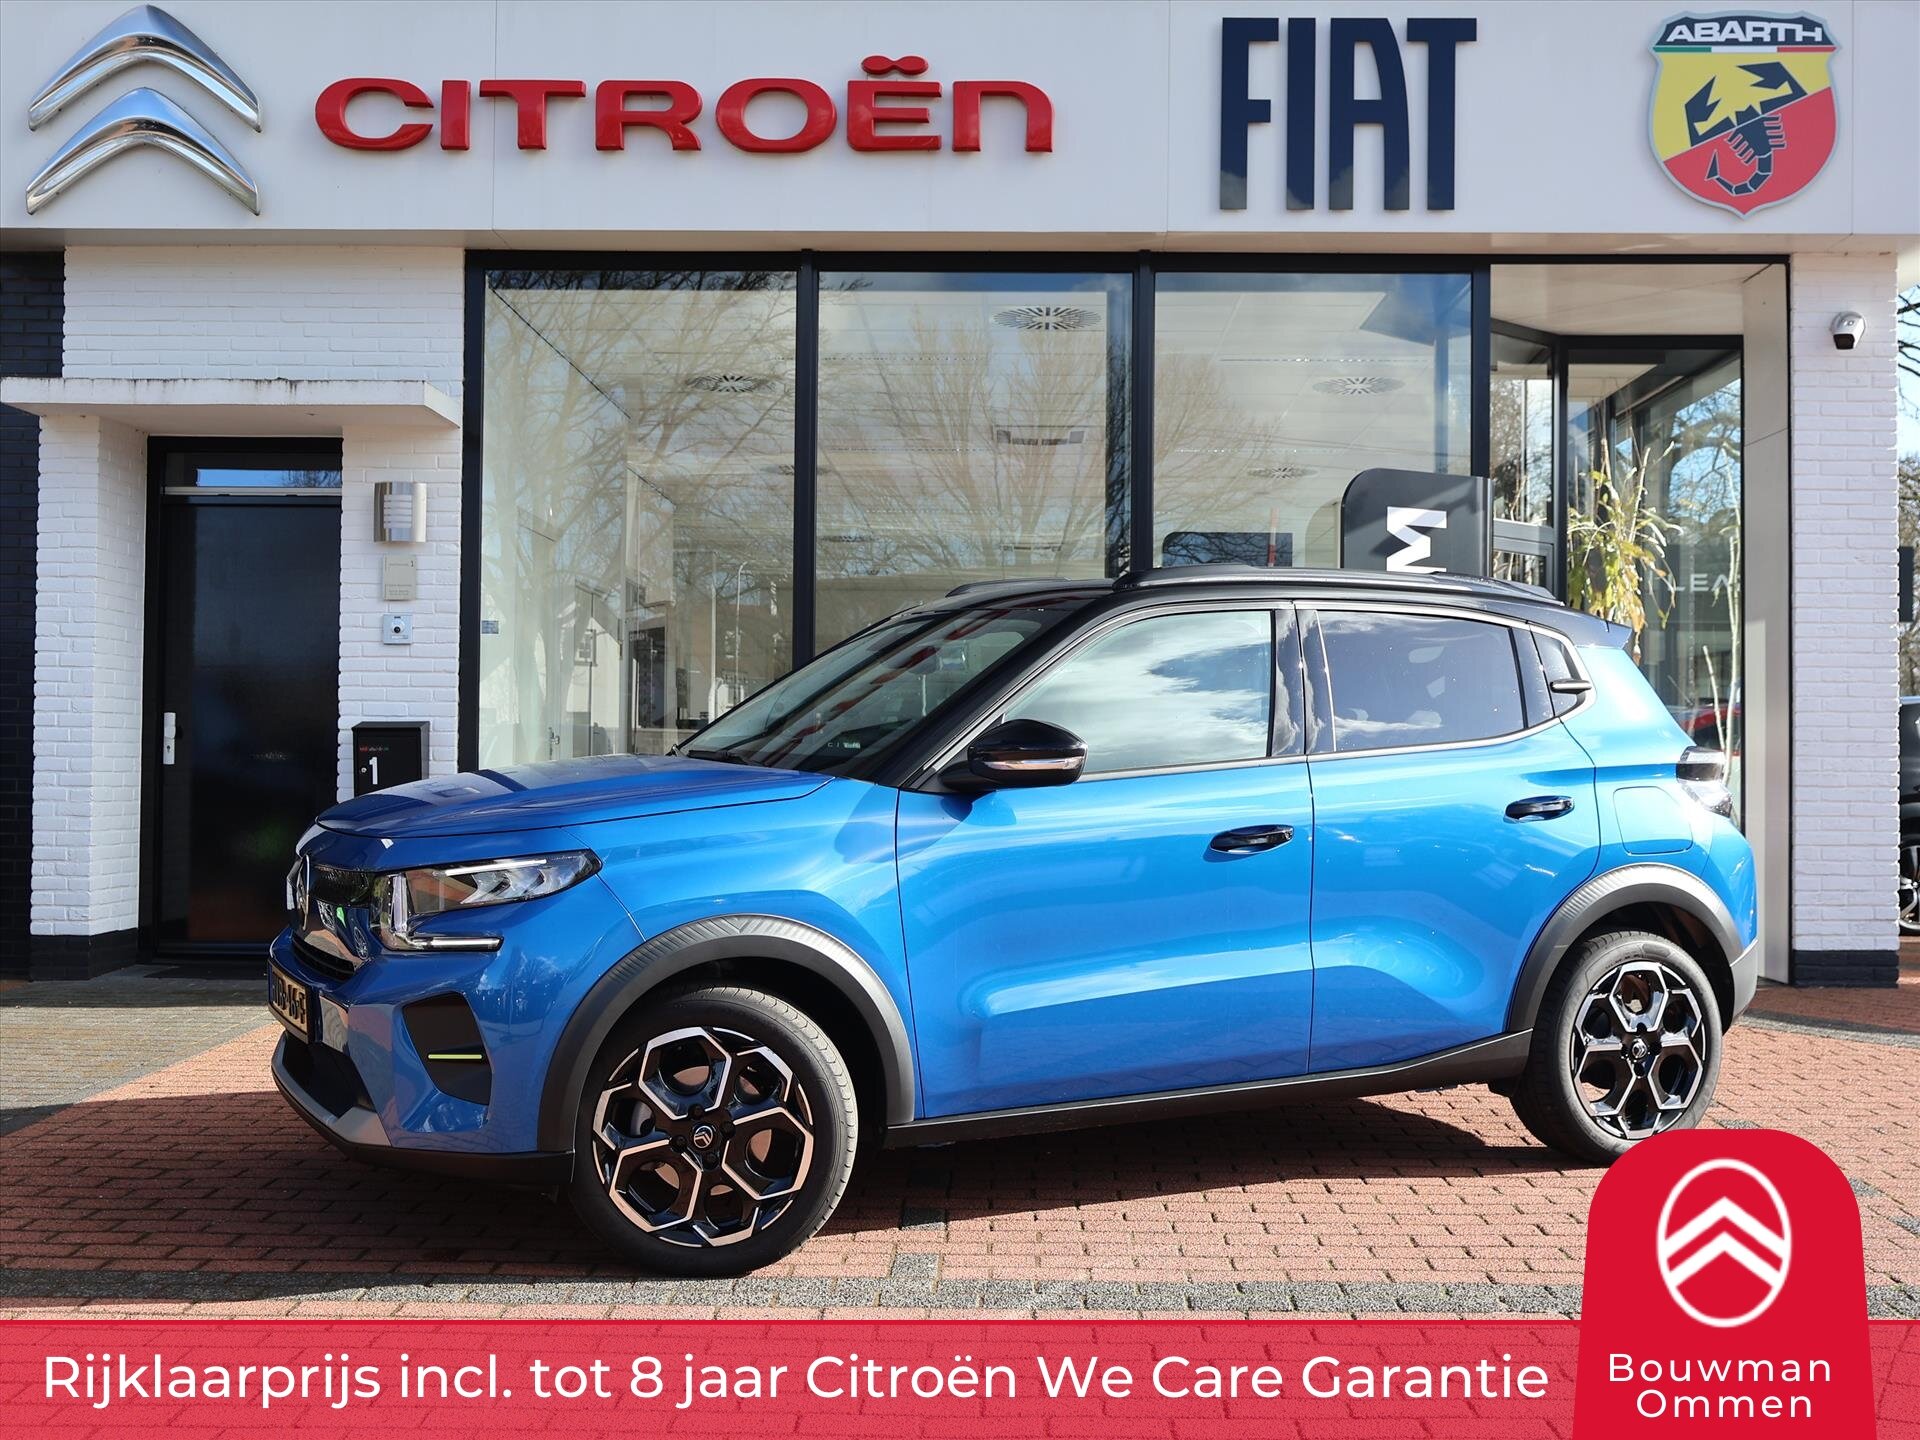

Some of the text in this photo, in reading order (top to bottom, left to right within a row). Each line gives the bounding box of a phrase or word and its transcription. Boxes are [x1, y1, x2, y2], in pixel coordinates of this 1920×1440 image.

[1666, 20, 1823, 43] ABARTH
[315, 55, 1053, 155] CITROËN
[1220, 17, 1477, 211] FIAT
[369, 756, 378, 785] 1
